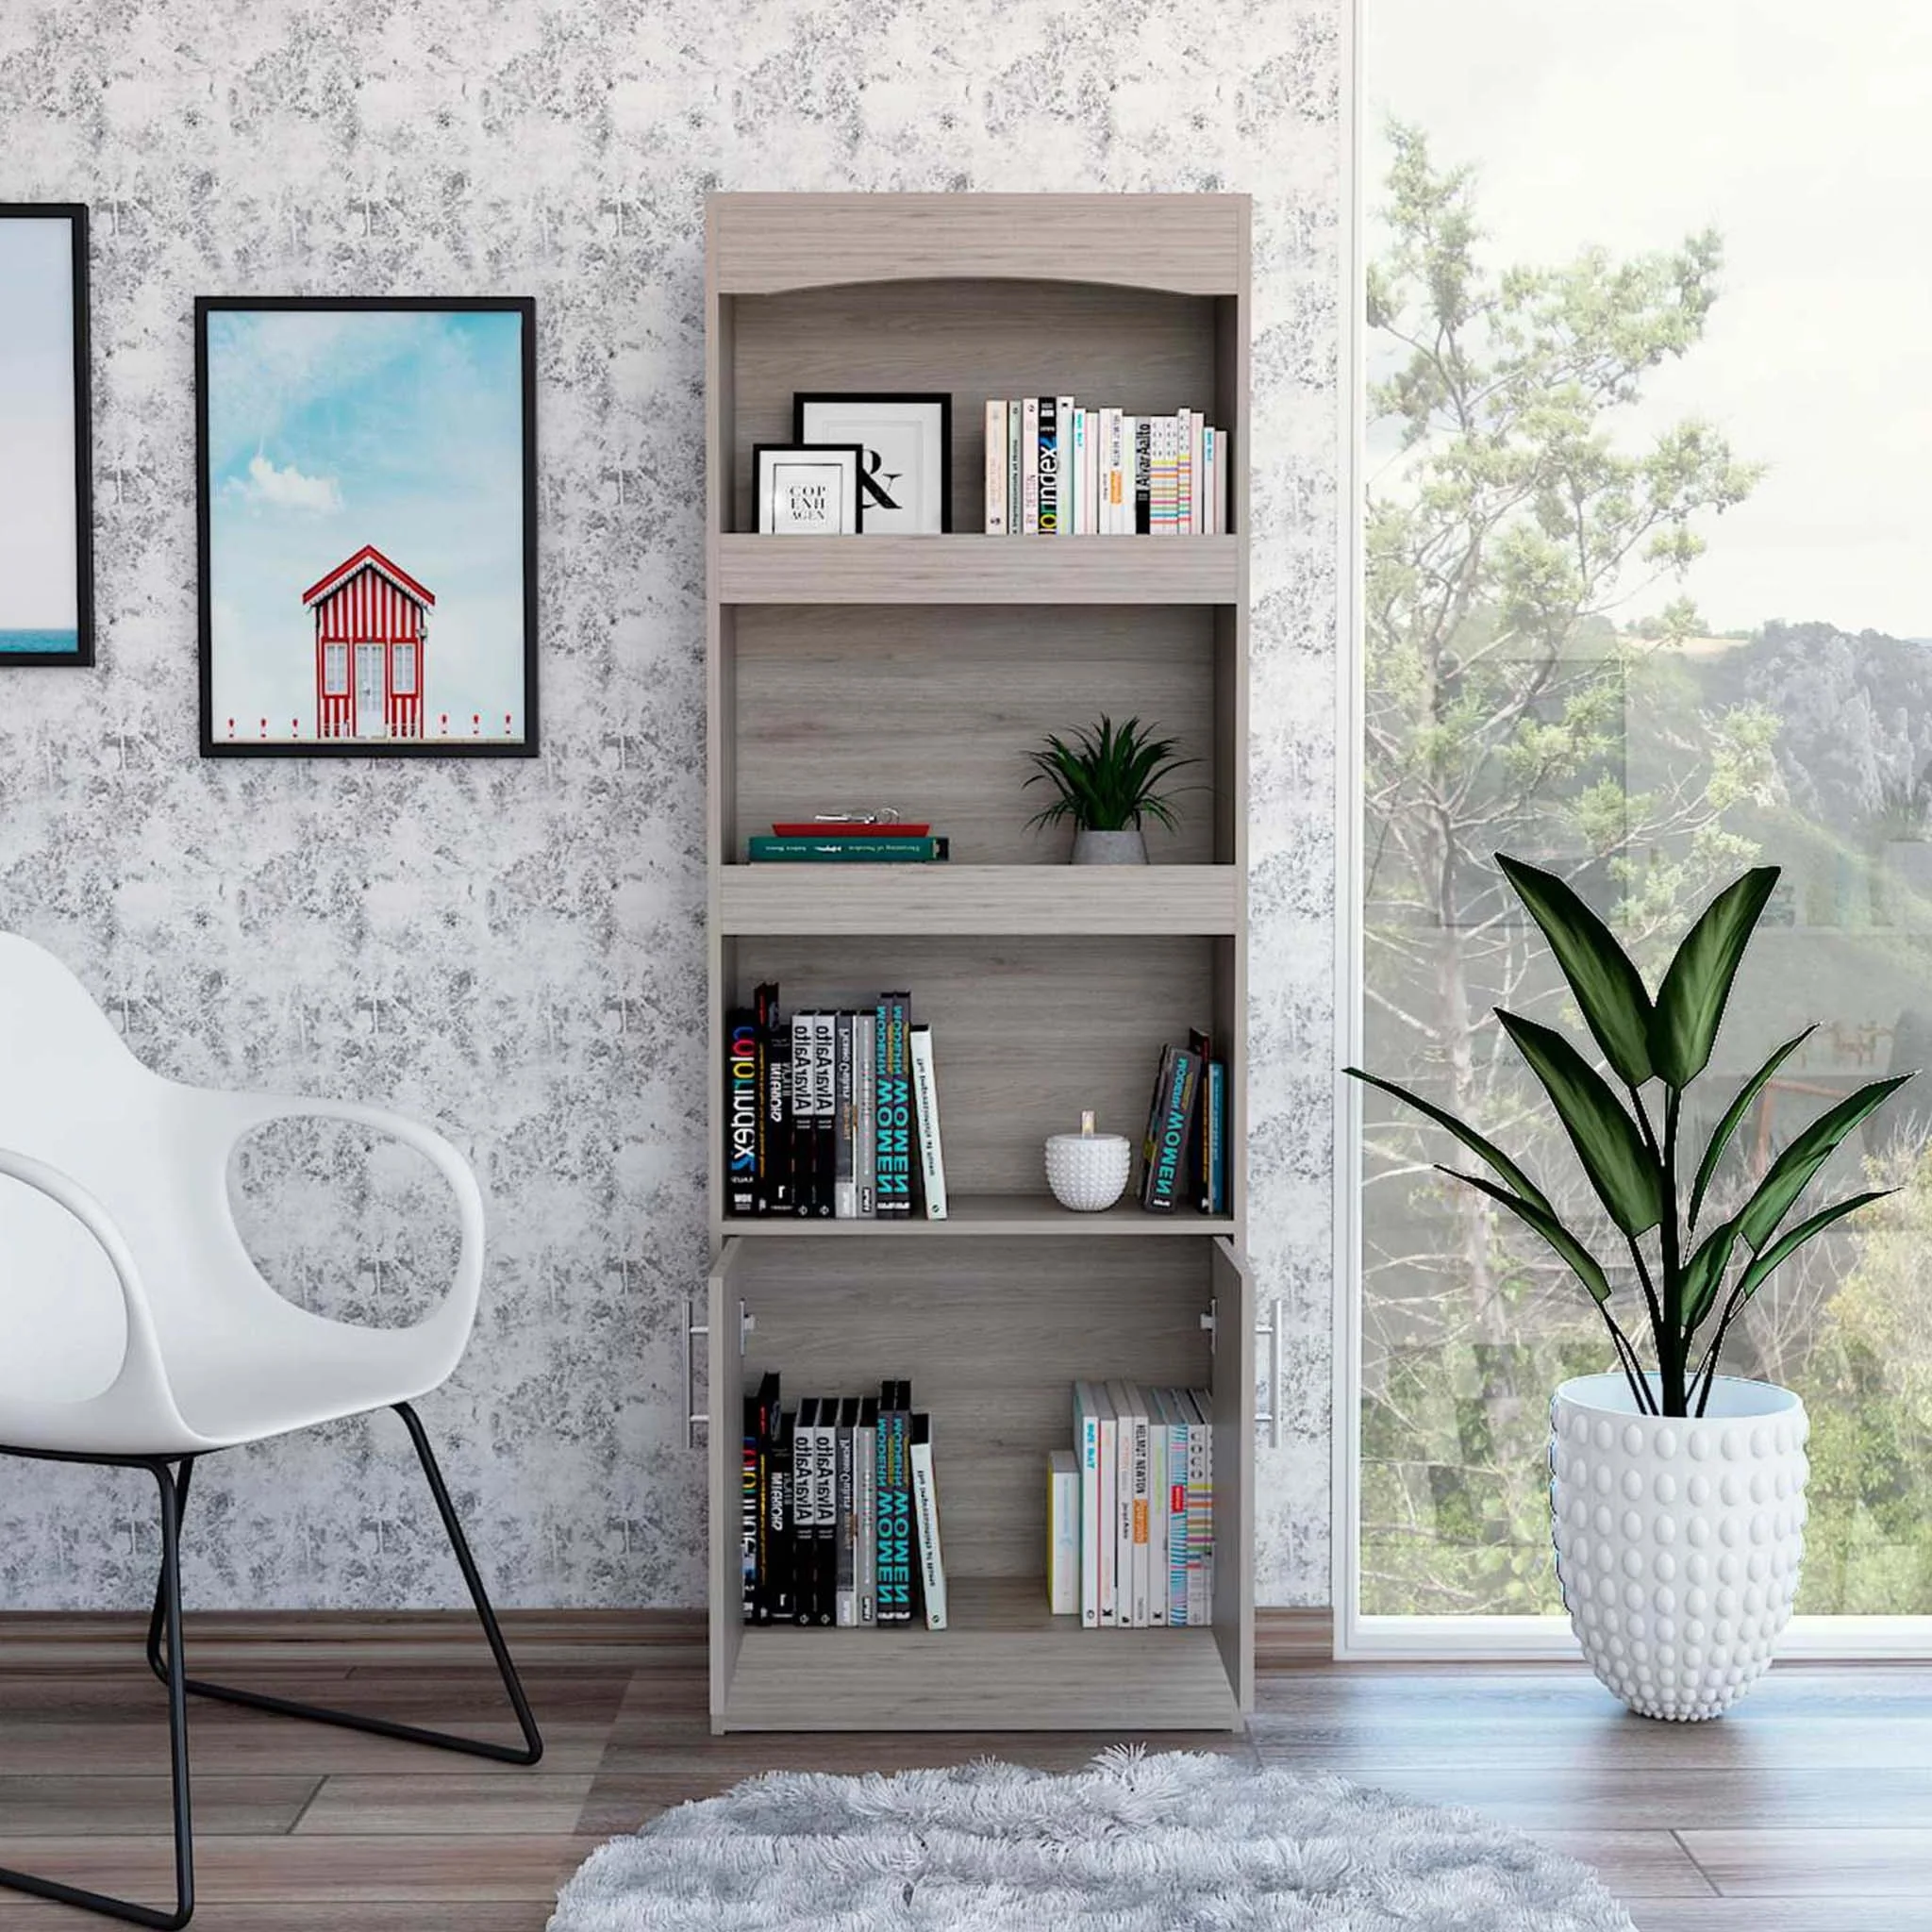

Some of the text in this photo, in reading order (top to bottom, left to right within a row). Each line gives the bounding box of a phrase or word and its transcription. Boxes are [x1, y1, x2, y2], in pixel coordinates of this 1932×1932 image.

[1137, 424, 1150, 486] AlvarAalto
[790, 486, 825, 497] COP
[791, 497, 824, 509] ENH
[1135, 1424, 1146, 1457] HELMUT
[1135, 1459, 1146, 1494] NEWTON
